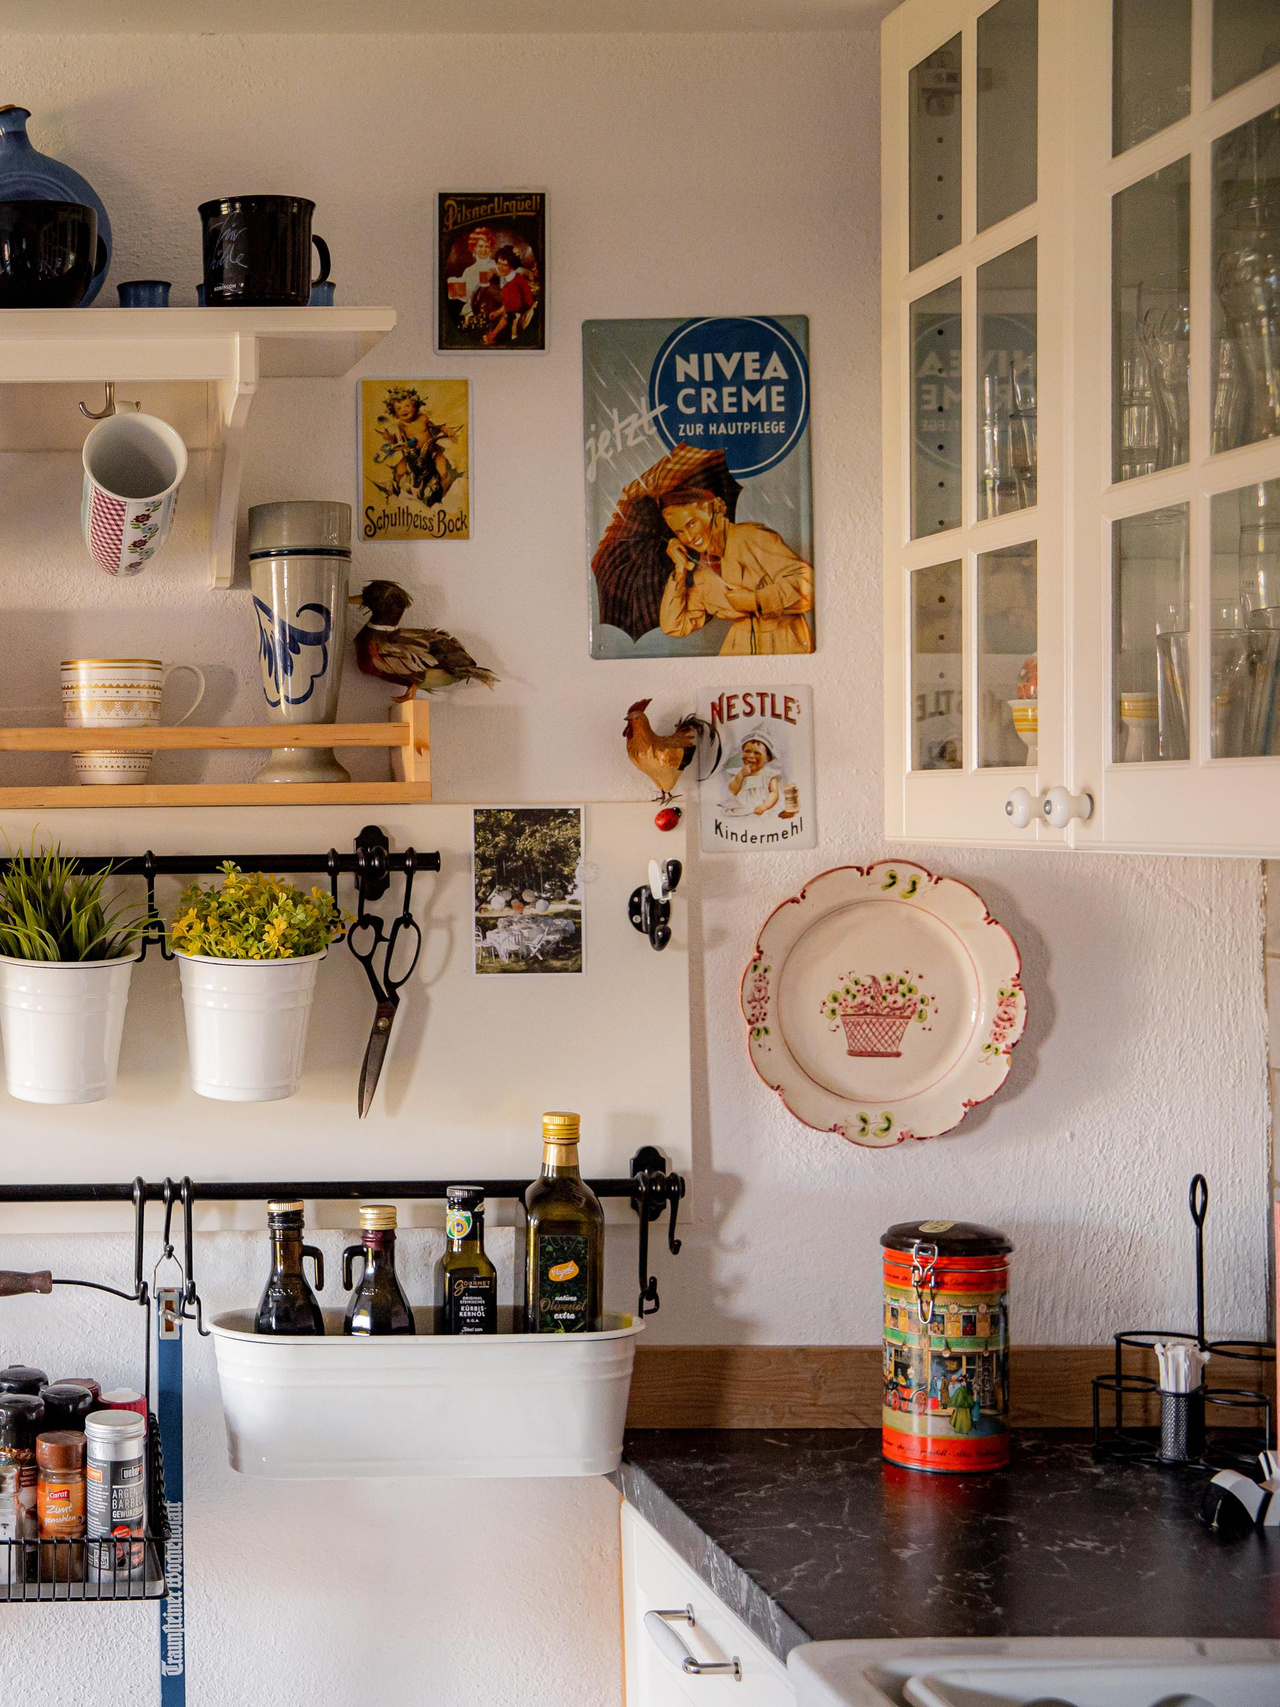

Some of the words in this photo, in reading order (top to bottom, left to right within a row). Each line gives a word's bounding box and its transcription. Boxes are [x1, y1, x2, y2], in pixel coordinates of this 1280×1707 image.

[675, 351, 789, 383] NIVEA
[677, 386, 786, 414] CREME
[585, 396, 669, 483] jetzt
[678, 423, 705, 437] ZUR
[708, 420, 787, 436] HAUTPFLEGE
[436, 508, 468, 538] Bock
[714, 817, 804, 844] Kindermehl
[553, 1311, 576, 1319] extra
[49, 1490, 68, 1499] Carat
[45, 1503, 73, 1514] Zimt
